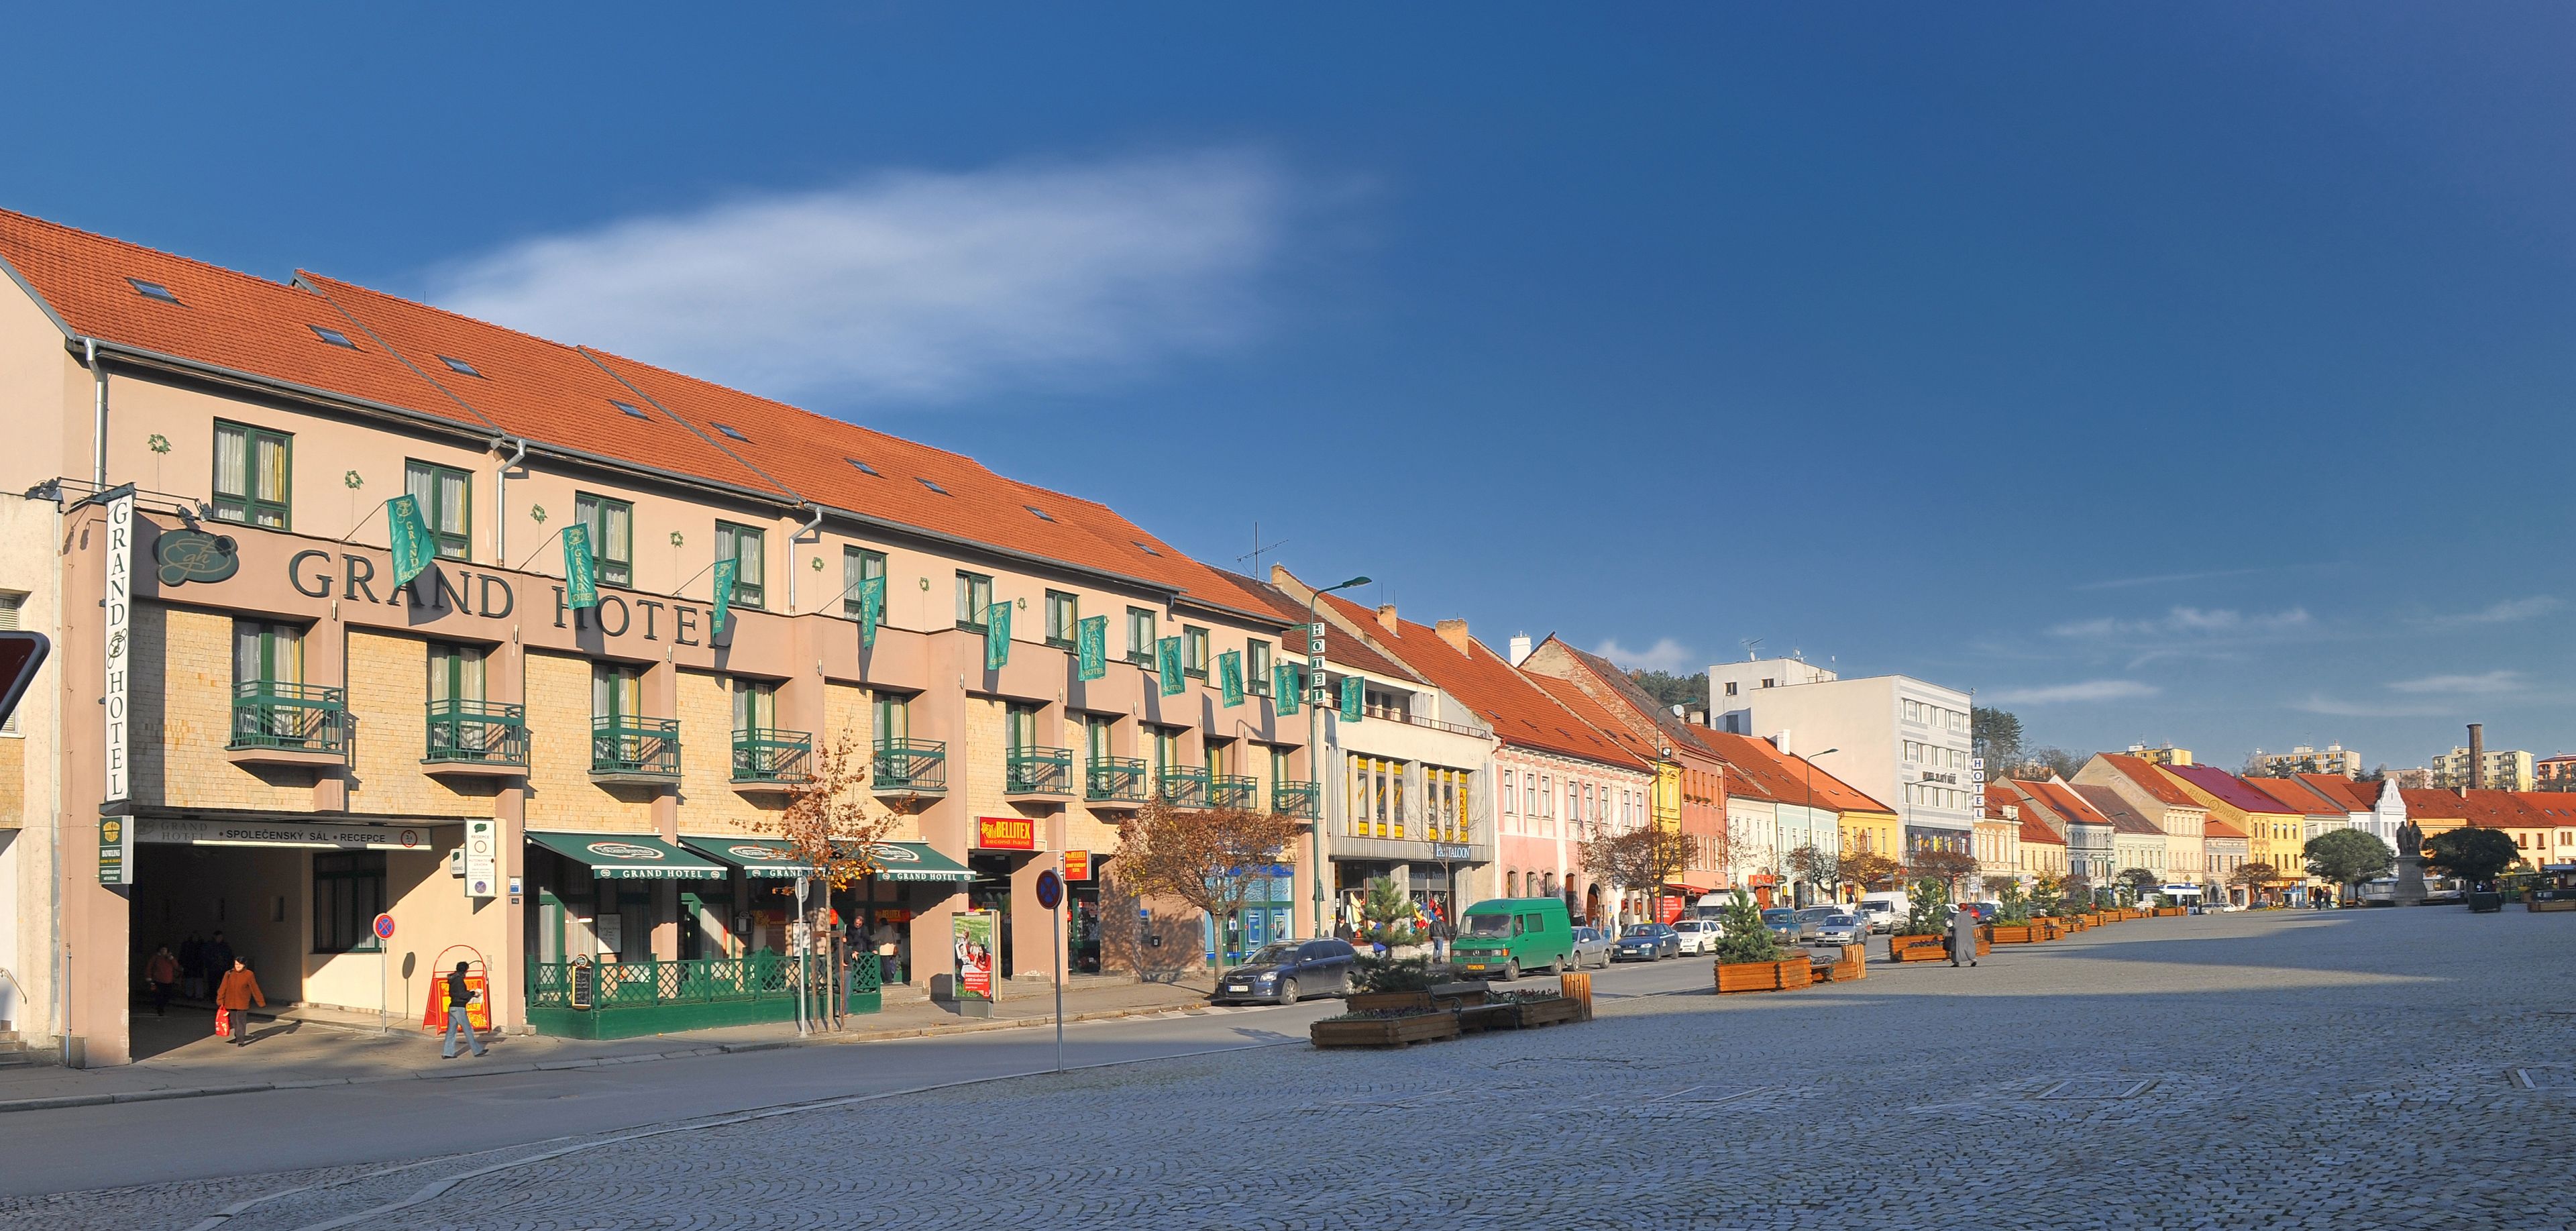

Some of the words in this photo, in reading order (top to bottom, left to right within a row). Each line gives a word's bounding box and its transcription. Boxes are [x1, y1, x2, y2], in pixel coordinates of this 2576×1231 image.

[405, 521, 419, 568] GRAND
[110, 502, 128, 627] GRAND
[574, 549, 585, 591] GRAND
[288, 549, 514, 619] GRAND
[551, 585, 732, 649] HOTEL
[1083, 667, 1104, 676] HOTEL
[1312, 624, 1322, 702] HOTEL
[1224, 696, 1243, 704] HOTEL
[109, 670, 124, 796] HOTEL
[1974, 759, 1982, 818] HOTEL
[2188, 788, 2211, 805] REALITY
[2218, 805, 2244, 824] DVOŘÁK
[161, 822, 207, 831] GRAND
[226, 828, 304, 841] SPOLEČENSKÝ
[309, 831, 329, 841] SÁL
[340, 833, 386, 843] RECEPCE
[996, 820, 1030, 839] BELLITEX
[101, 849, 121, 857] BOWLING
[1436, 843, 1470, 859] PANTALOON
[623, 869, 662, 878] GRAND
[667, 869, 703, 878] HOTEL
[769, 869, 804, 877] GRAND
